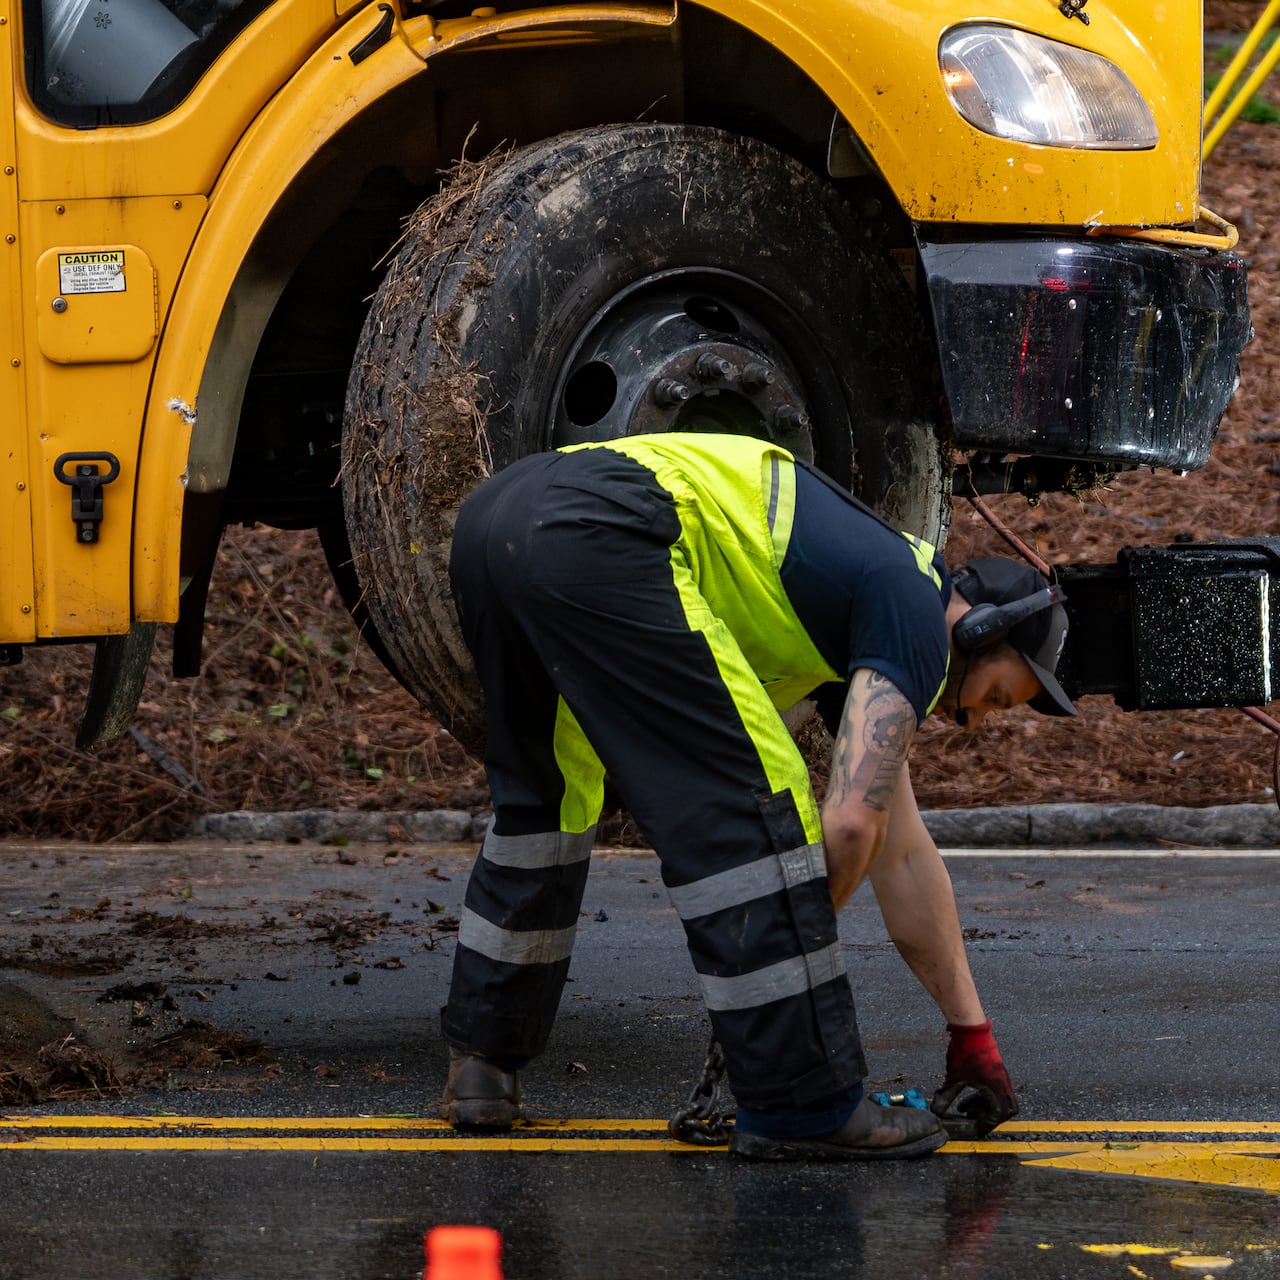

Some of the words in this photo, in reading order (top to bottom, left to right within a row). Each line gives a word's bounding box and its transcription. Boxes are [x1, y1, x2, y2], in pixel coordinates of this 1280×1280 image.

[64, 253, 119, 265] CAUTION
[72, 265, 86, 273] USE
[103, 263, 121, 271] ONLY
